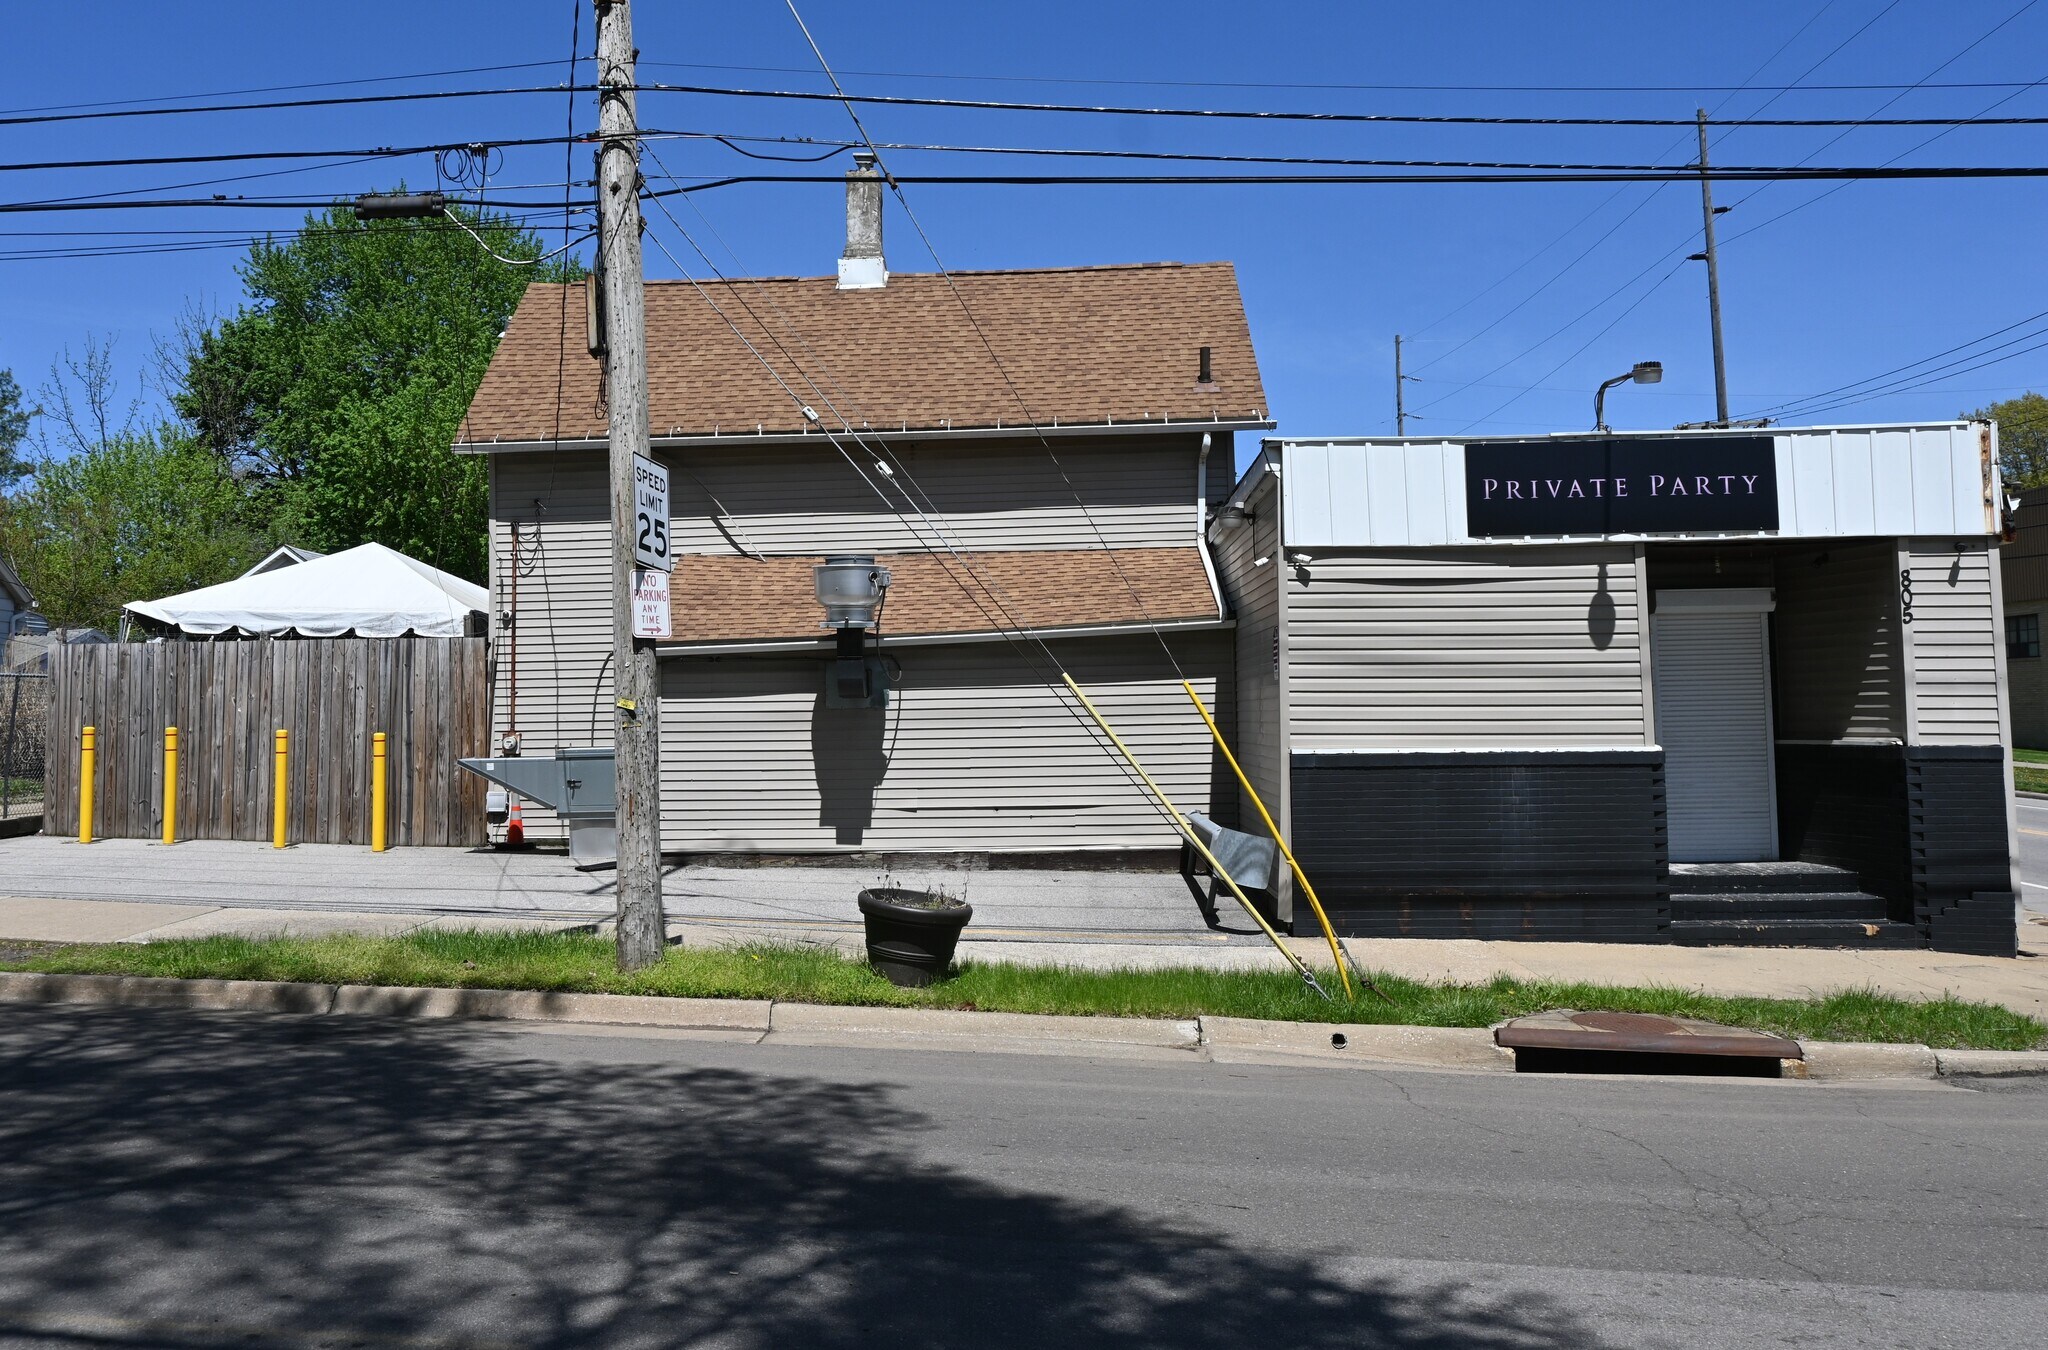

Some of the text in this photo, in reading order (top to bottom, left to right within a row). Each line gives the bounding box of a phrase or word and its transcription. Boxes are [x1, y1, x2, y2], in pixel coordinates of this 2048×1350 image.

[636, 466, 666, 493] SPEED
[1482, 475, 1758, 500] PRIVATE PARTY
[639, 489, 663, 514] LIMIT
[638, 512, 667, 558] 25
[642, 574, 657, 587] NO
[633, 588, 667, 602] PARKING
[1901, 569, 1913, 625] 805
[641, 615, 660, 624] TIME
[642, 604, 658, 613] ANY
